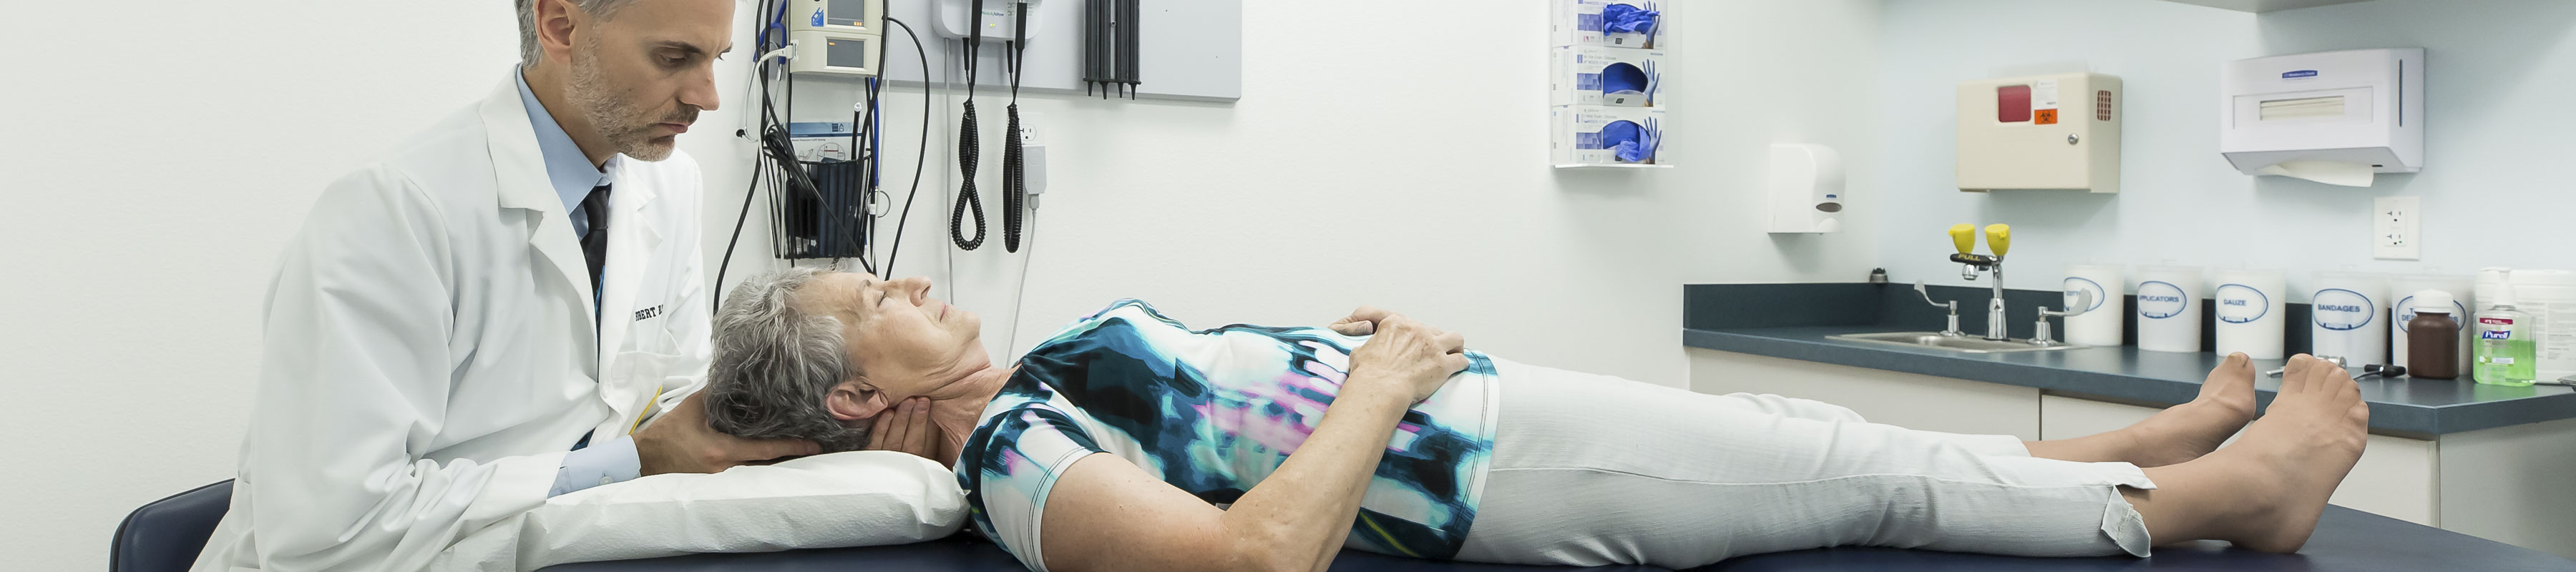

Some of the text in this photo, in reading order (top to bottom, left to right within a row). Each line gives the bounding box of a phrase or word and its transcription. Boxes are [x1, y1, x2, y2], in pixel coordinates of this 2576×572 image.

[1958, 253, 1981, 262] PULL
[2318, 303, 2361, 312] BANDAGES
[2485, 330, 2509, 339] Purell
